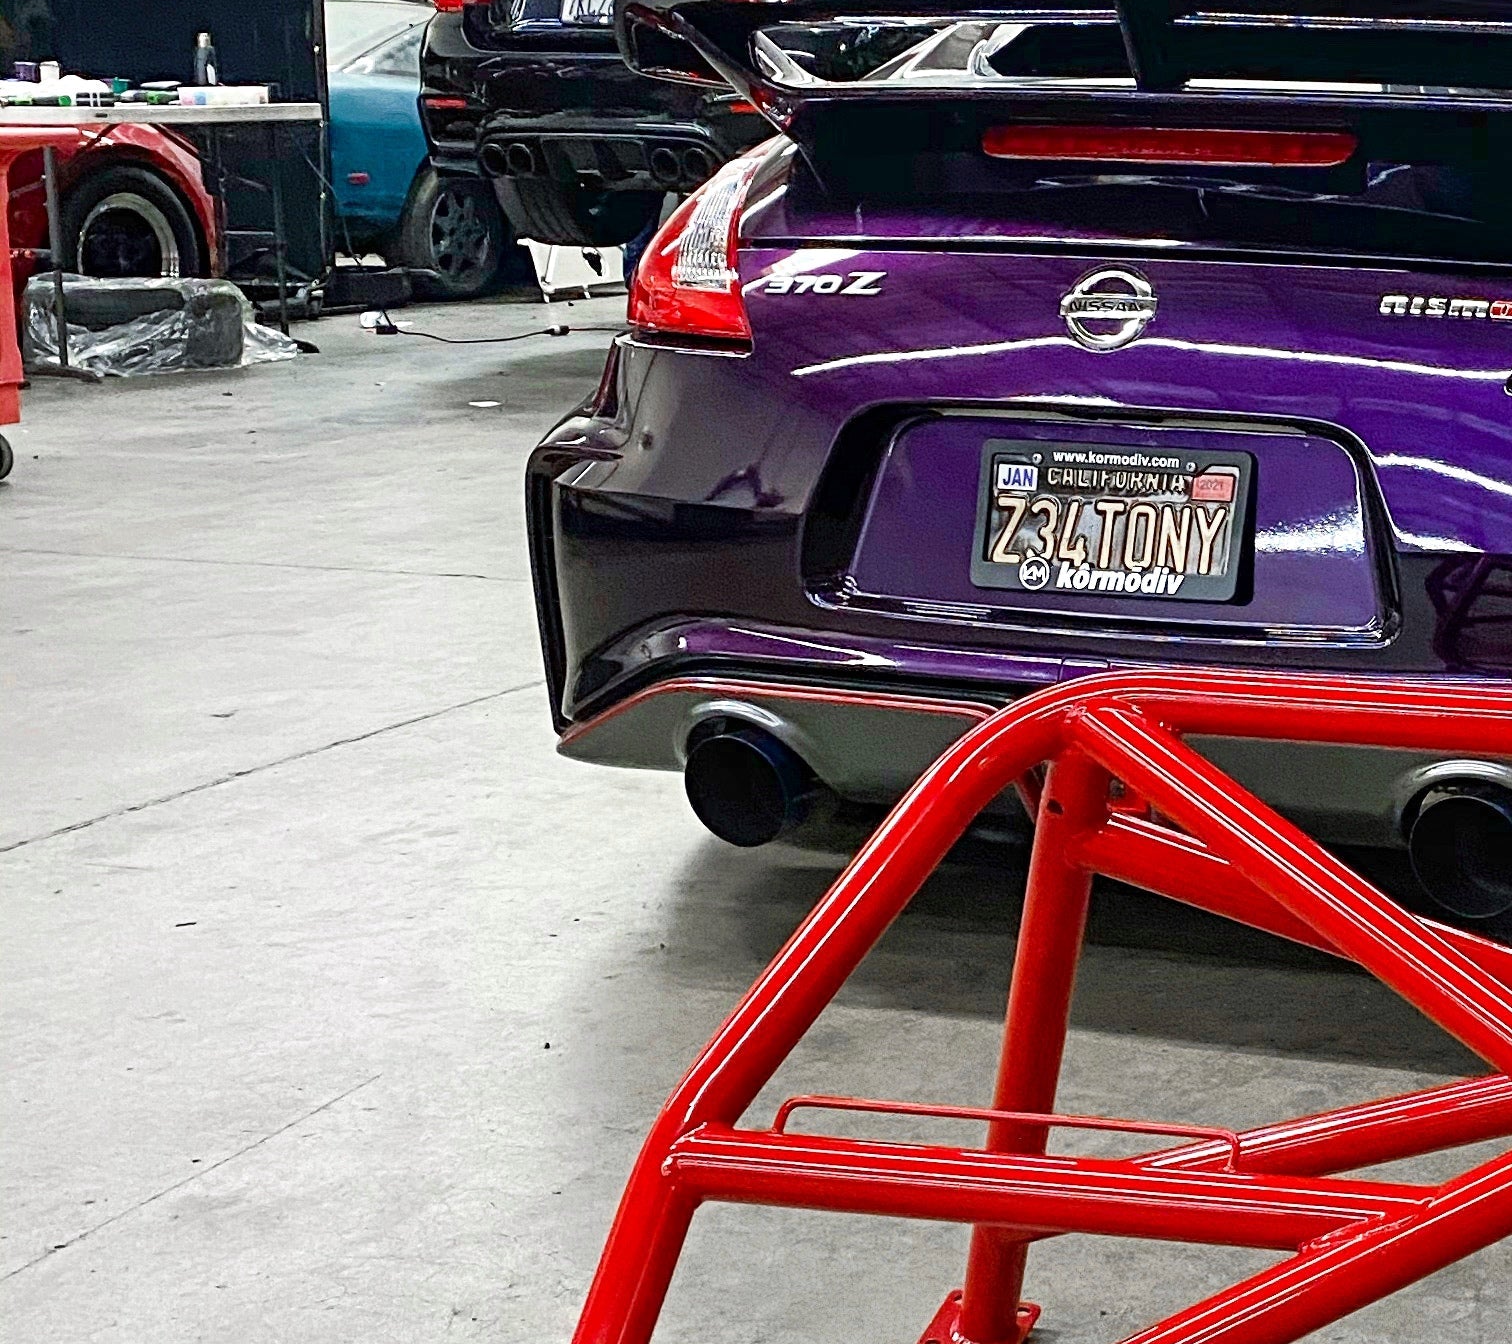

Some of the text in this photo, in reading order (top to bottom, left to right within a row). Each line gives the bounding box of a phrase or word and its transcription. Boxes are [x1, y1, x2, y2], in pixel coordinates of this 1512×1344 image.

[1053, 451, 1180, 469] www.kormodiv.com
[1003, 467, 1034, 487] JAN
[1048, 467, 1186, 493] CALIFORNIA
[992, 497, 1226, 574] Z34TONY
